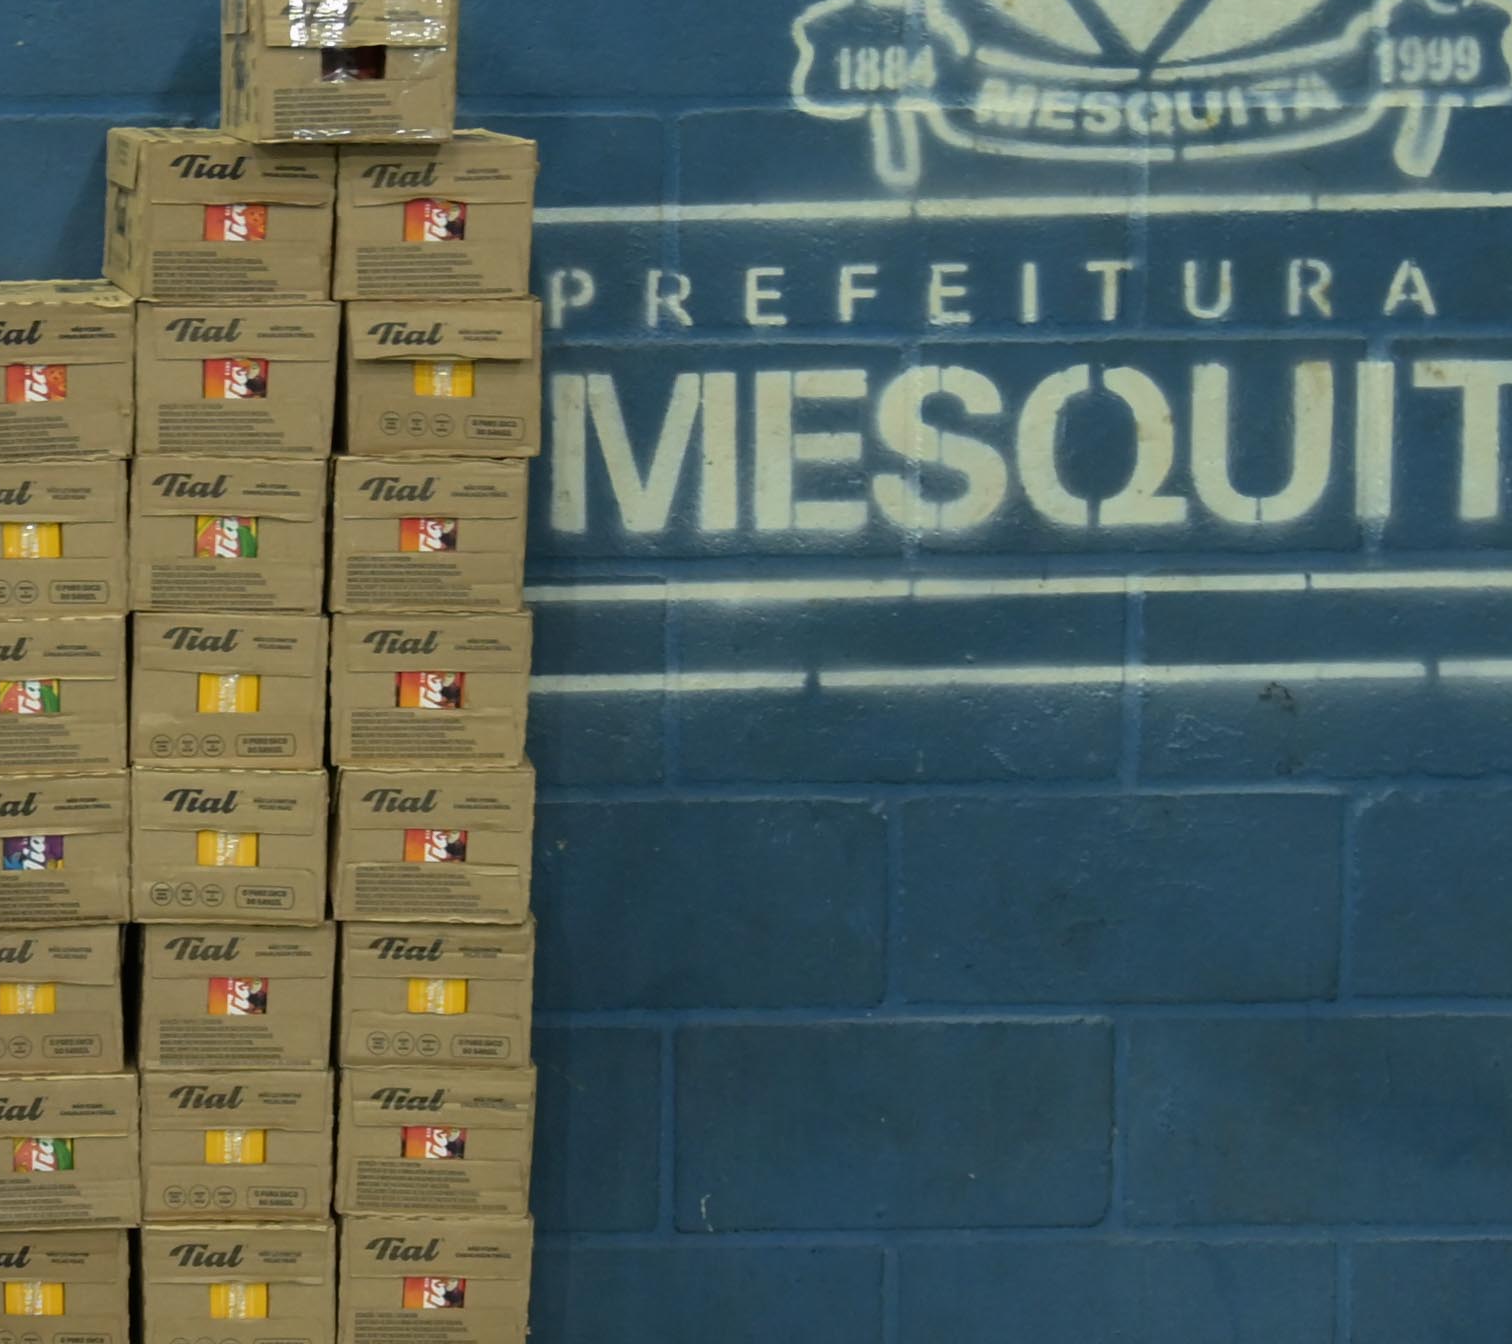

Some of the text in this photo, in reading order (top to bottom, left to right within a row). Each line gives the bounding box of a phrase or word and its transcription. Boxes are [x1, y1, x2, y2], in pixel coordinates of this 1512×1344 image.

[1373, 33, 1482, 84] 1999
[976, 69, 1342, 137] MESQUITA
[170, 154, 247, 180] Tial
[362, 163, 437, 188] Tial
[549, 258, 1439, 333] PREFEITURA
[165, 318, 244, 342] Tial
[368, 323, 442, 345] Tial
[152, 473, 227, 498] Tial
[359, 477, 435, 501] Tial
[163, 627, 238, 652] Tial
[362, 630, 438, 654] Tial
[163, 789, 237, 813] Tial
[362, 789, 437, 812] Tial
[165, 937, 239, 961] Tial
[169, 1086, 243, 1109] Tial
[170, 1244, 243, 1267] Tial
[365, 1237, 440, 1261] Tial
